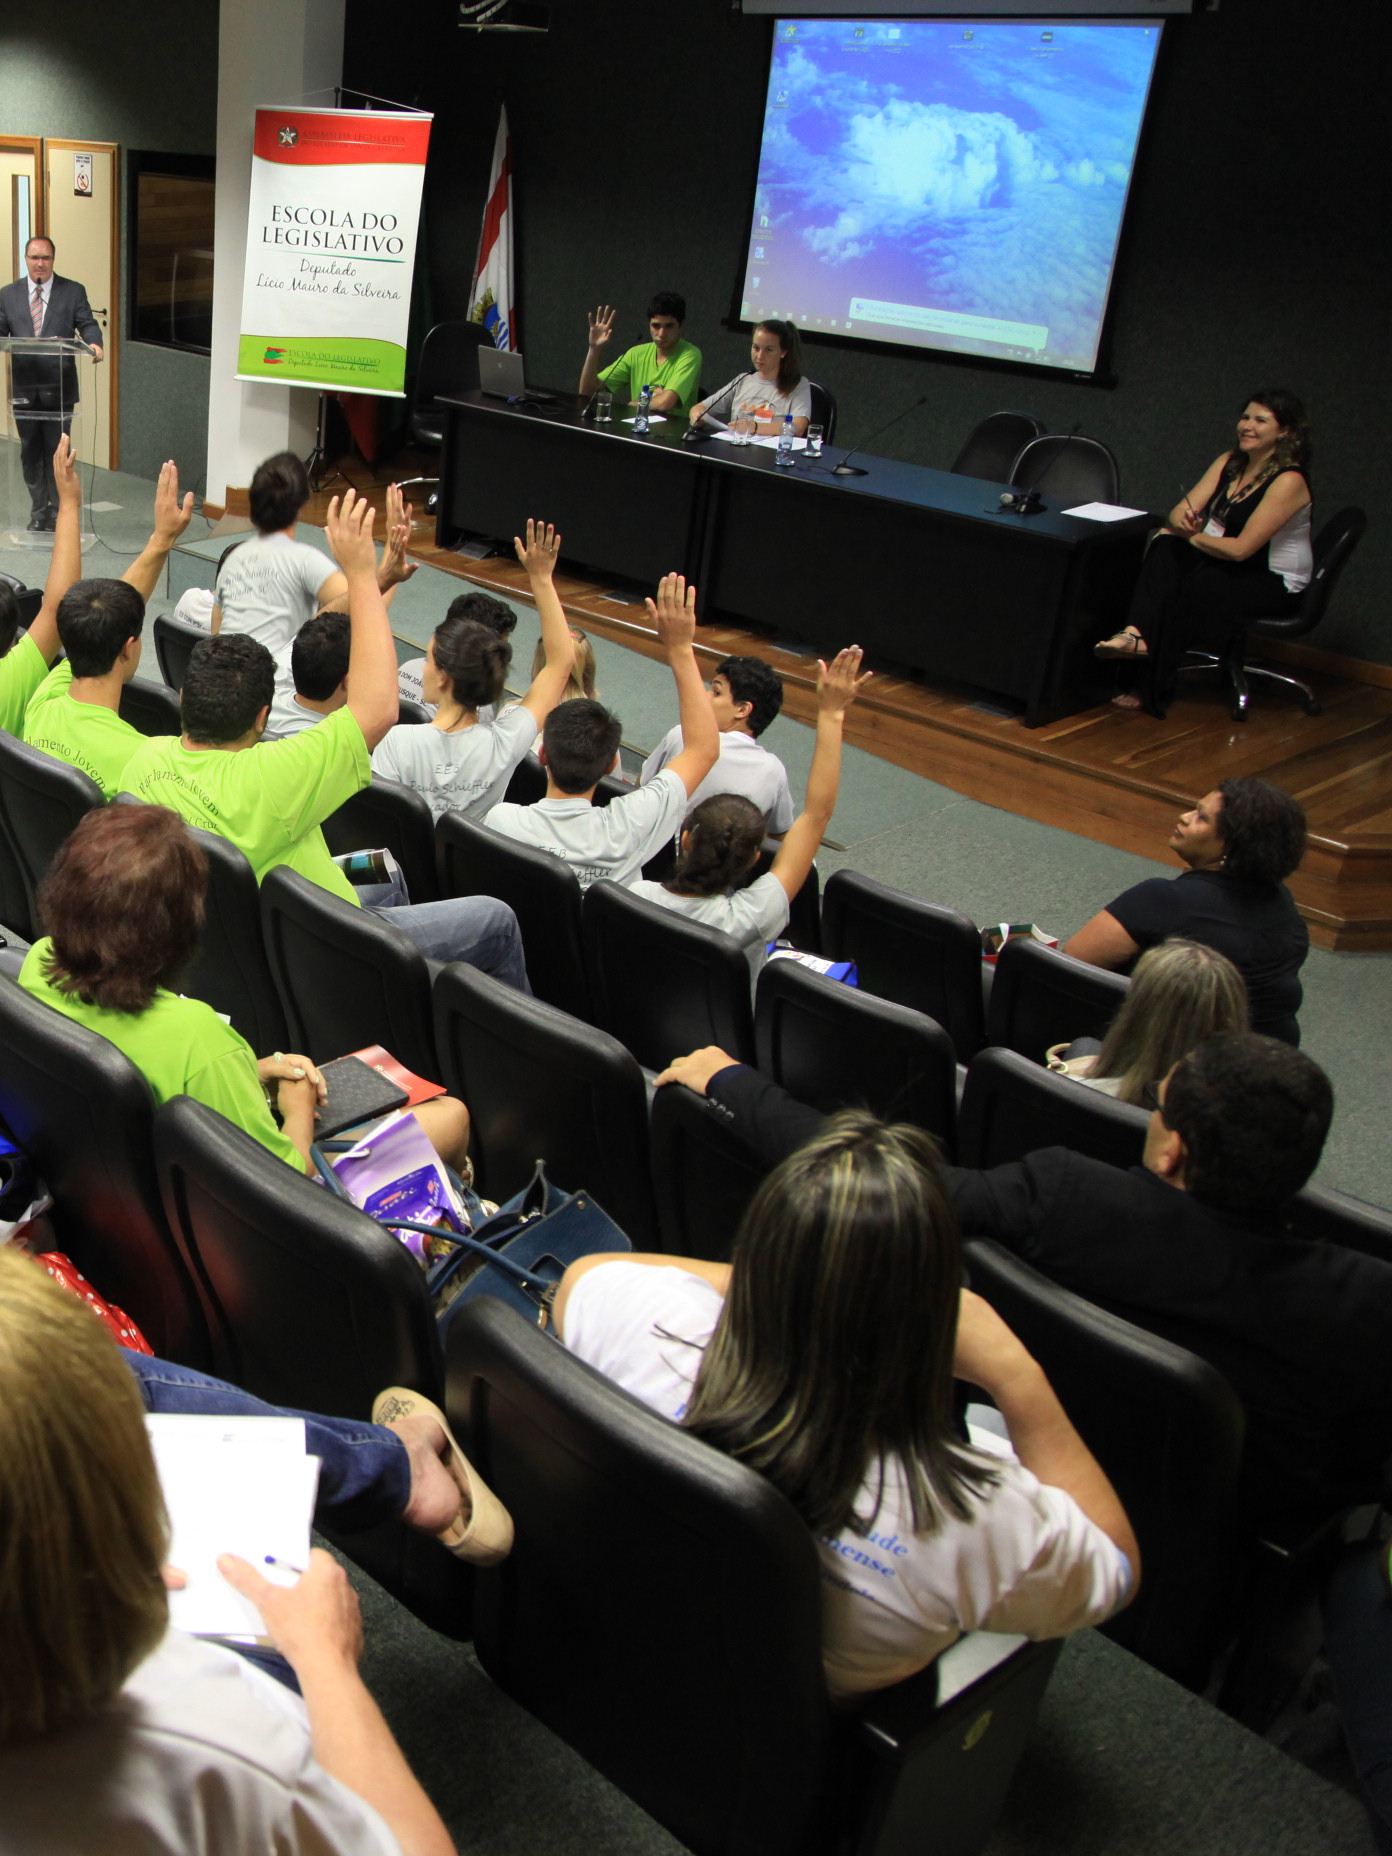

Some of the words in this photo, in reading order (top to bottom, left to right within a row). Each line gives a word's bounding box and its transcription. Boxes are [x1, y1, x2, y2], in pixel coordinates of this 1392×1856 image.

[272, 205, 355, 229] ESCOLA
[362, 212, 398, 232] DO
[262, 226, 404, 254] LEGISLATIVO
[300, 258, 357, 280] Deputado
[256, 273, 285, 289] Lício
[287, 277, 329, 294] Mauro
[332, 280, 349, 296] da
[351, 282, 402, 300] Silveira
[289, 349, 316, 359] ESCOLA
[333, 355, 381, 365] LEGISLATIVO
[401, 671, 412, 681] DOM
[72, 750, 106, 790] Jovem
[576, 866, 612, 882] effler
